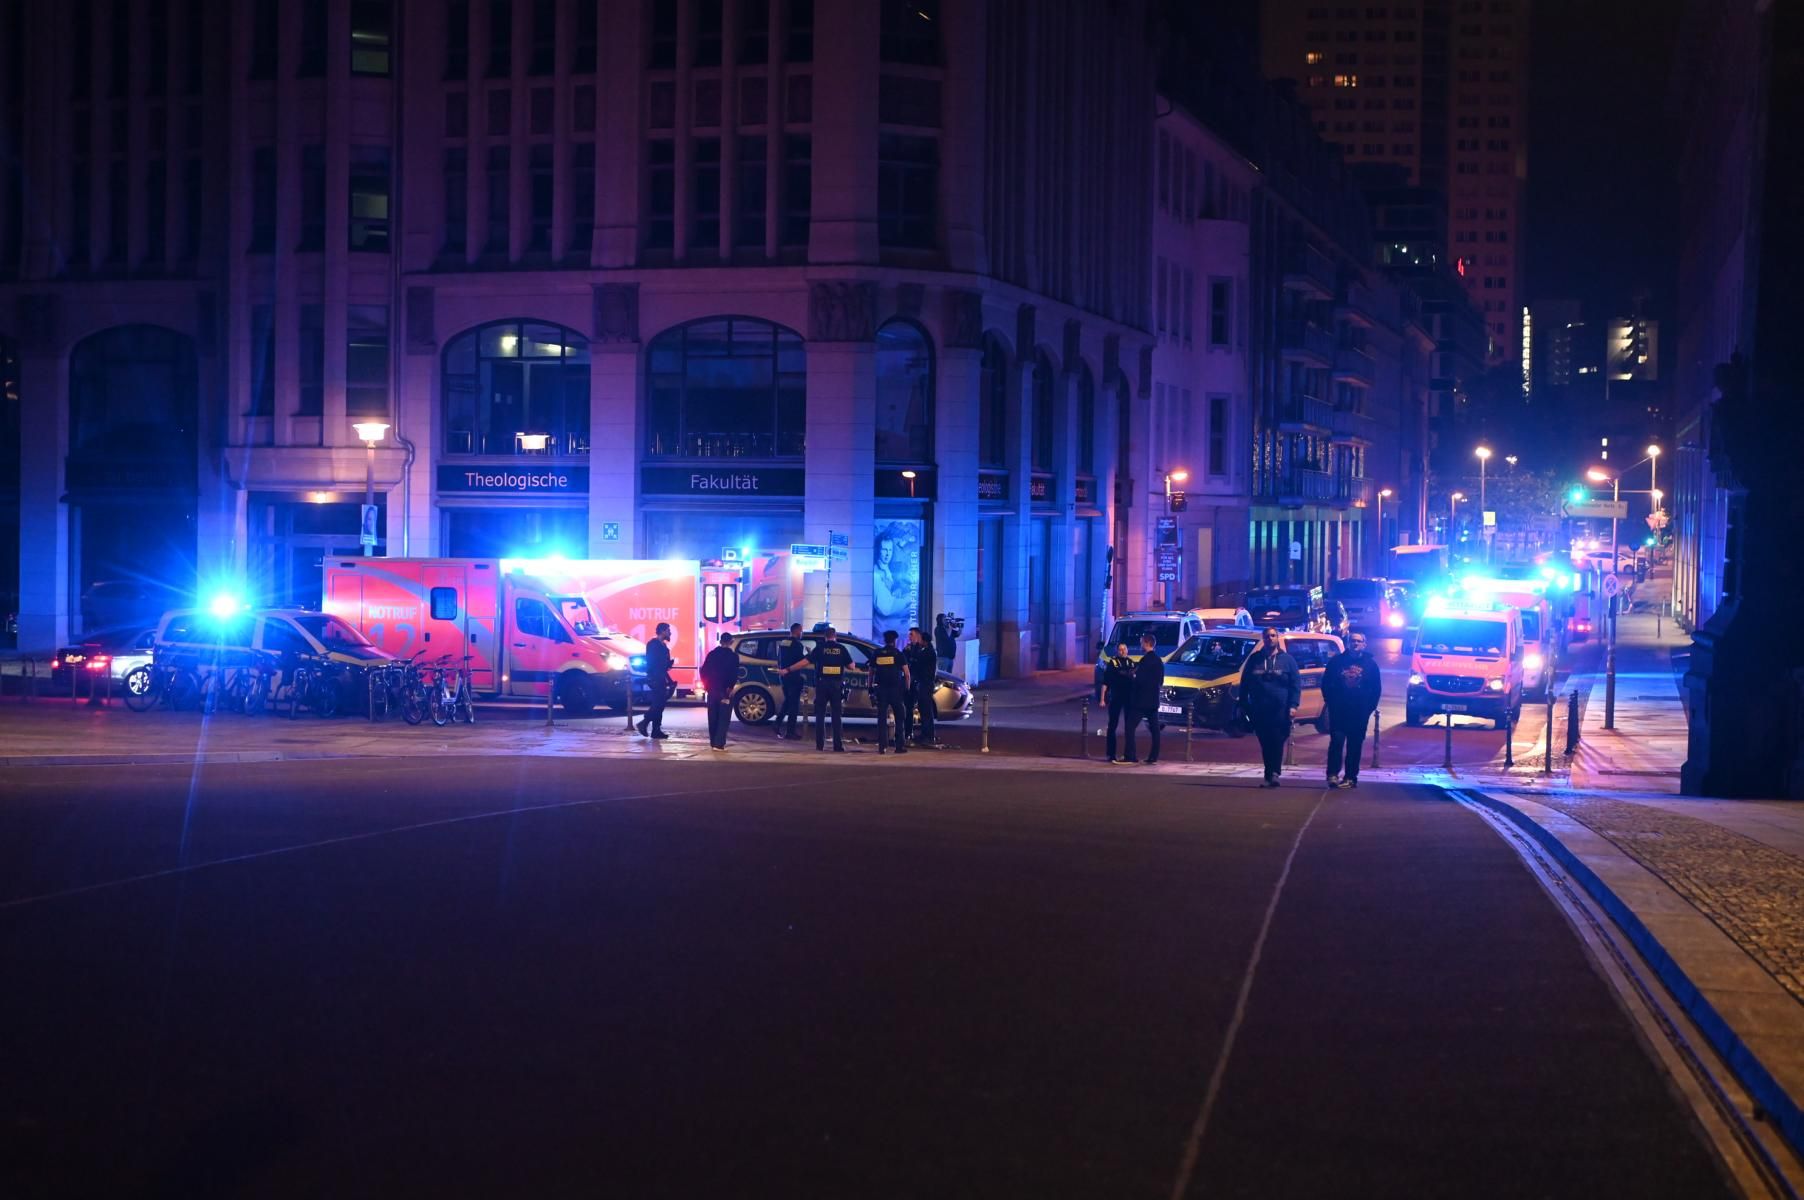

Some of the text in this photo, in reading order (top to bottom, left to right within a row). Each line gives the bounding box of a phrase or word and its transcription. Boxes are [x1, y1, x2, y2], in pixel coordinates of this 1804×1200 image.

[464, 472, 759, 491] Theologische Fakultät
[1159, 573, 1176, 581] SPD
[369, 606, 417, 619] NOTRUF
[629, 607, 679, 620] NOTRUF
